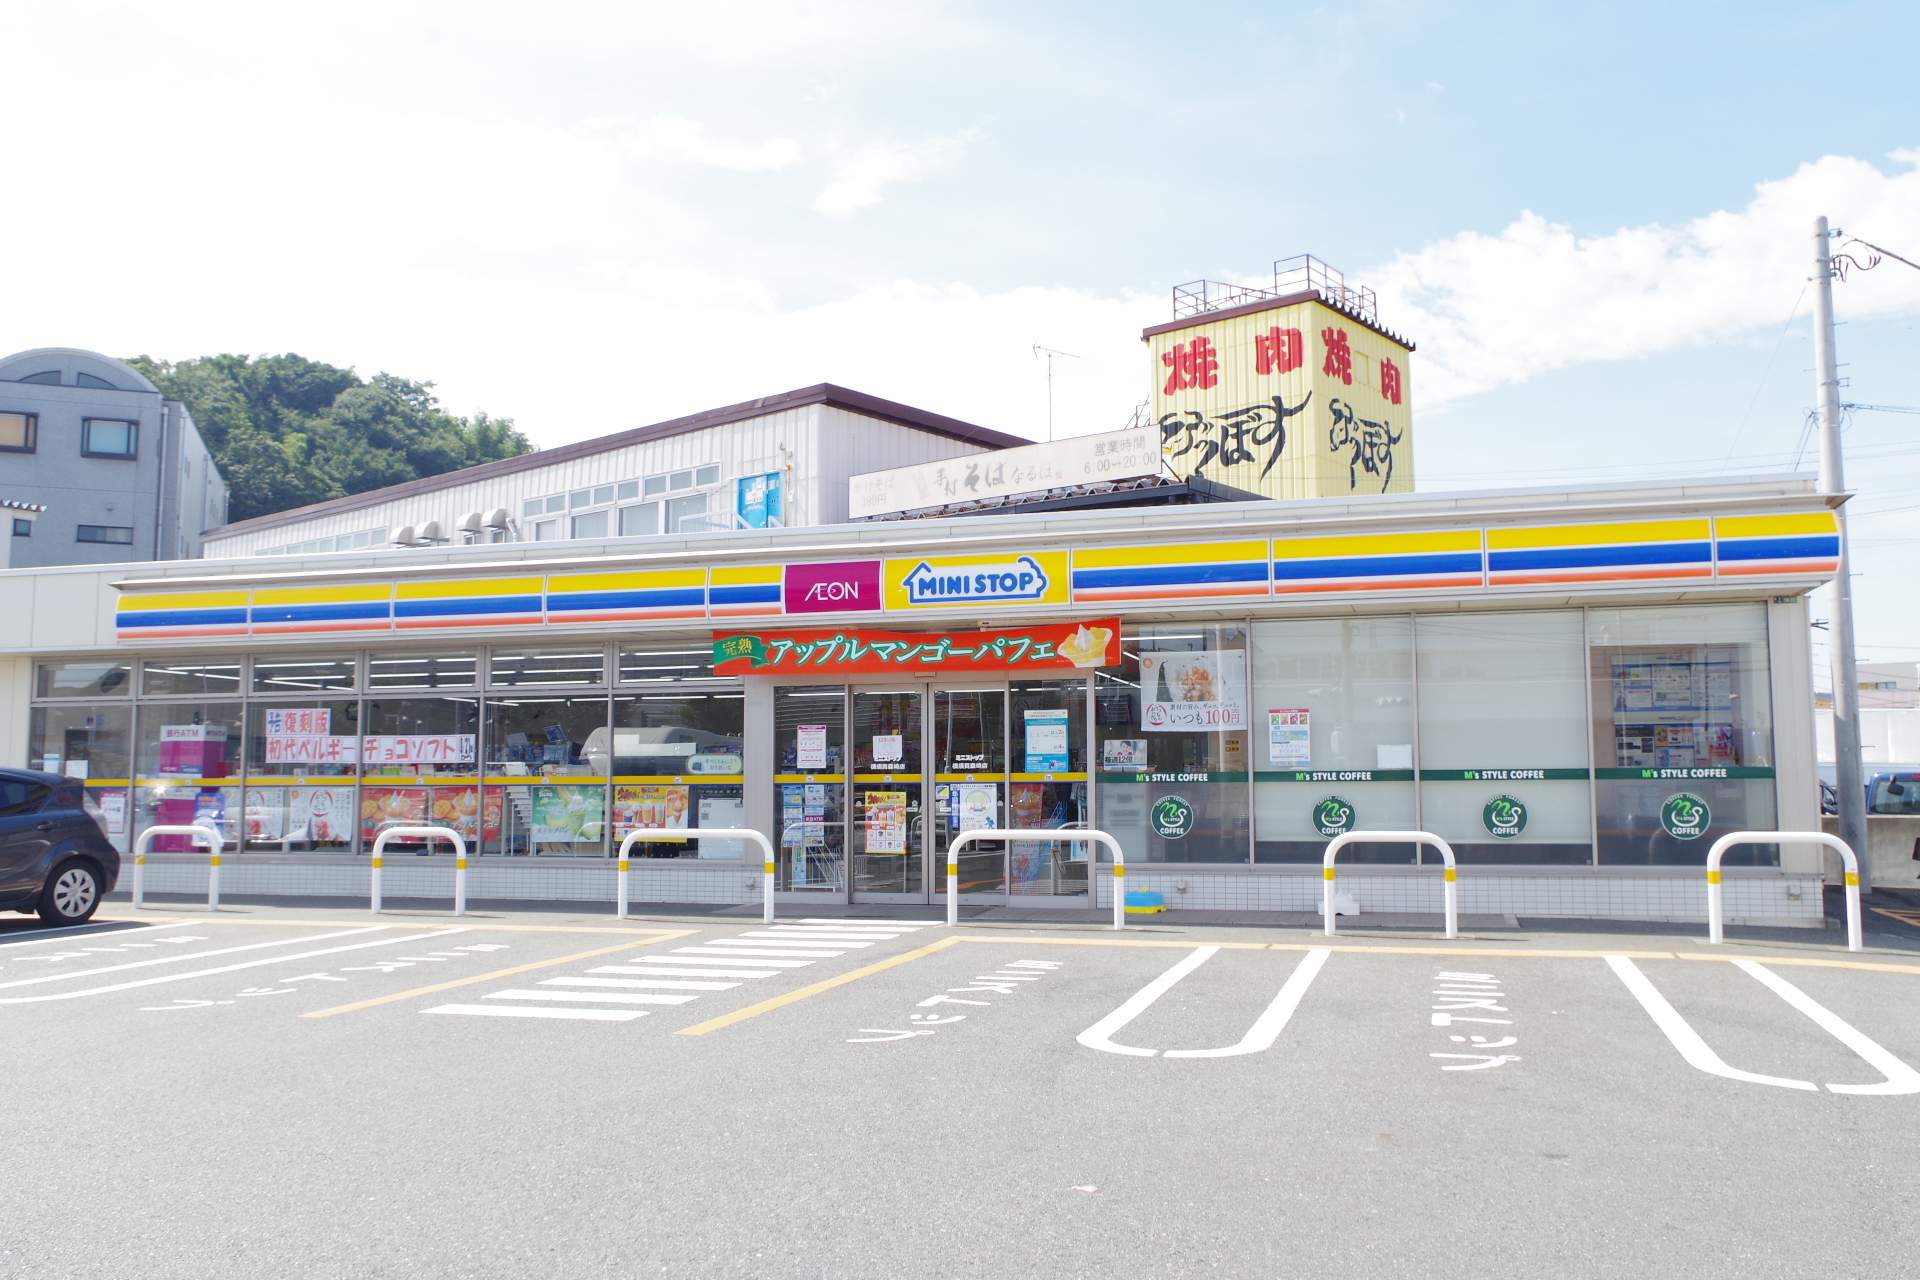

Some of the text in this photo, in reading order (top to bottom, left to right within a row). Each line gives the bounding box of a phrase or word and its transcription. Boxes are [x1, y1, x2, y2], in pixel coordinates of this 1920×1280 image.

[1162, 326, 1303, 396] 焼肉
[1322, 326, 1402, 405] 焼肉
[1095, 435, 1146, 457] 営業時間
[918, 572, 1034, 596] MINI STOP
[722, 637, 752, 656] 完熟
[770, 634, 1056, 664] アップルマンゴーパフェ
[1136, 773, 1208, 782] M's STYLE COFFEE
[1296, 772, 1371, 781] M's STYLE COFFEE
[1464, 770, 1544, 779] M's STYLE COFFEE
[1642, 769, 1727, 778] M's STYLE COFFEE
